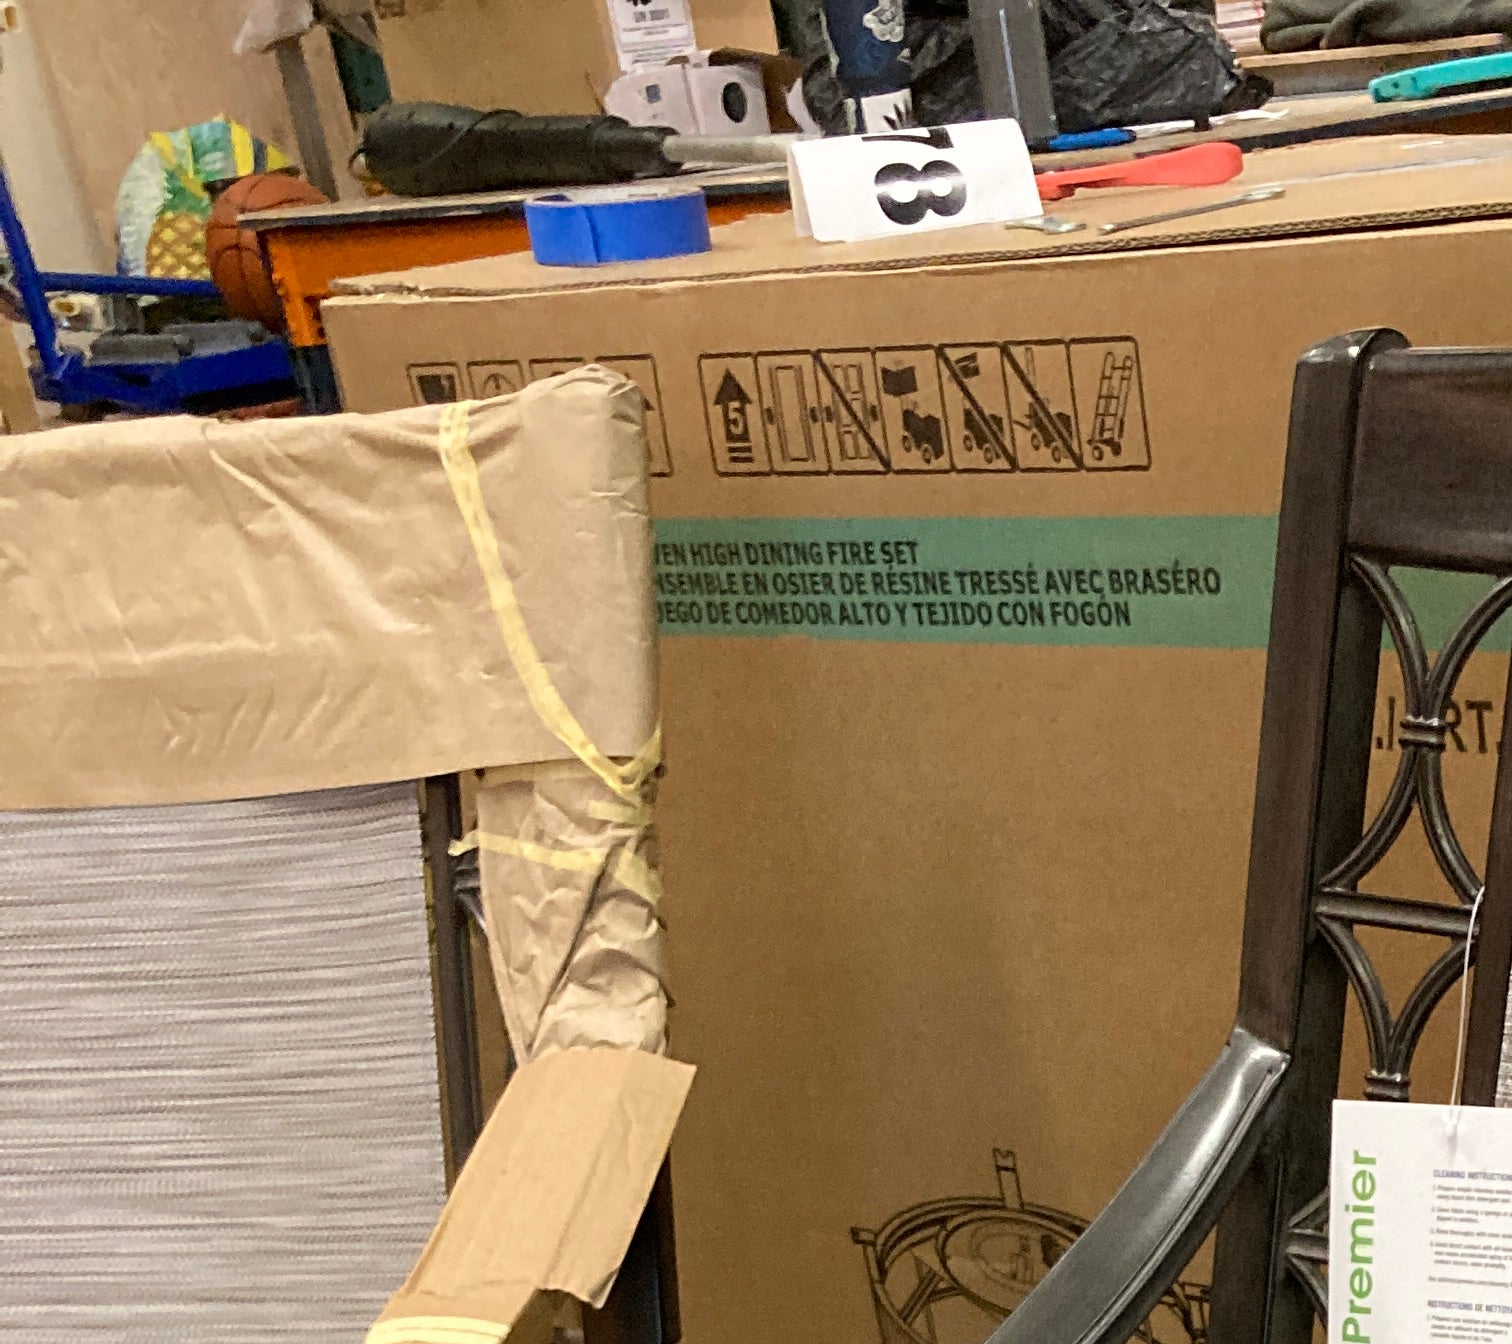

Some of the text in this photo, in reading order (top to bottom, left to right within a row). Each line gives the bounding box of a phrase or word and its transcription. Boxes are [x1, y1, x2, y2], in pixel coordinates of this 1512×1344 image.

[690, 542, 741, 566] HIGH
[745, 541, 824, 566] DINING
[826, 541, 877, 565] FIRE
[880, 540, 919, 565] SET
[742, 571, 769, 596] EN
[771, 571, 837, 596] OSIER
[841, 571, 868, 596] DE
[870, 564, 951, 596] RÉSINE
[954, 560, 1040, 596] TRESSÉ
[1045, 569, 1104, 595] AVEC
[1108, 558, 1222, 597] BRASÉRO
[706, 601, 735, 625] DE
[735, 601, 833, 625] COMEDOR
[838, 602, 891, 626] ALTO
[893, 602, 908, 626] Y
[911, 601, 993, 627] TEJIDO
[997, 601, 1045, 627] CON
[1048, 594, 1132, 627] FOGÓN
[1341, 1149, 1378, 1344] Premier
